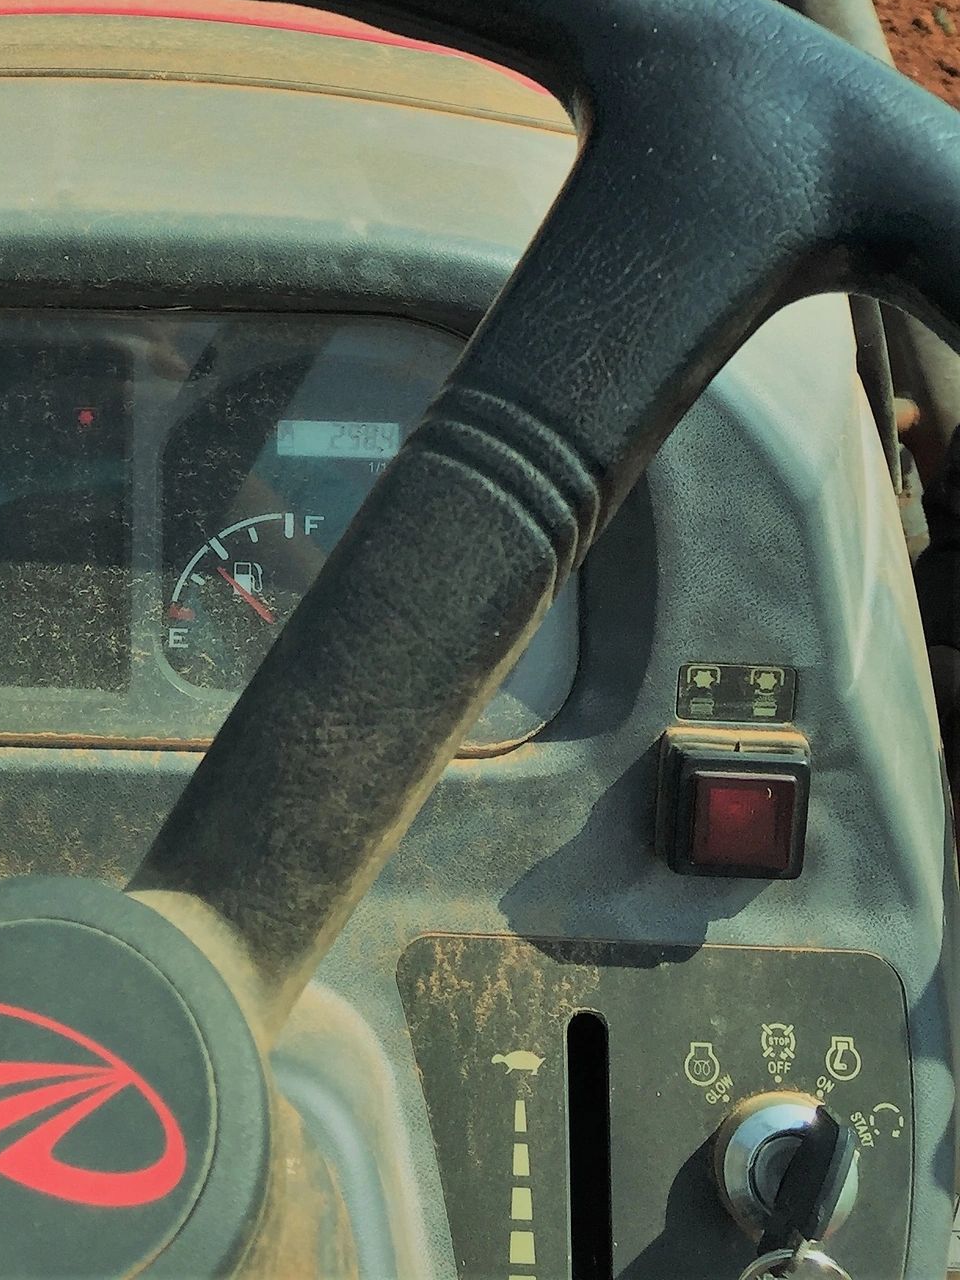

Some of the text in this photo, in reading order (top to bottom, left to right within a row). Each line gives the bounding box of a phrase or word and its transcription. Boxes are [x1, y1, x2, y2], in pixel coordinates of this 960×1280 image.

[305, 516, 325, 535] F
[168, 628, 189, 648] E
[768, 1036, 790, 1047] STOP
[768, 1061, 792, 1074] OFF
[705, 1074, 734, 1105] GLOW
[816, 1075, 834, 1093] ON
[850, 1111, 874, 1148] START
